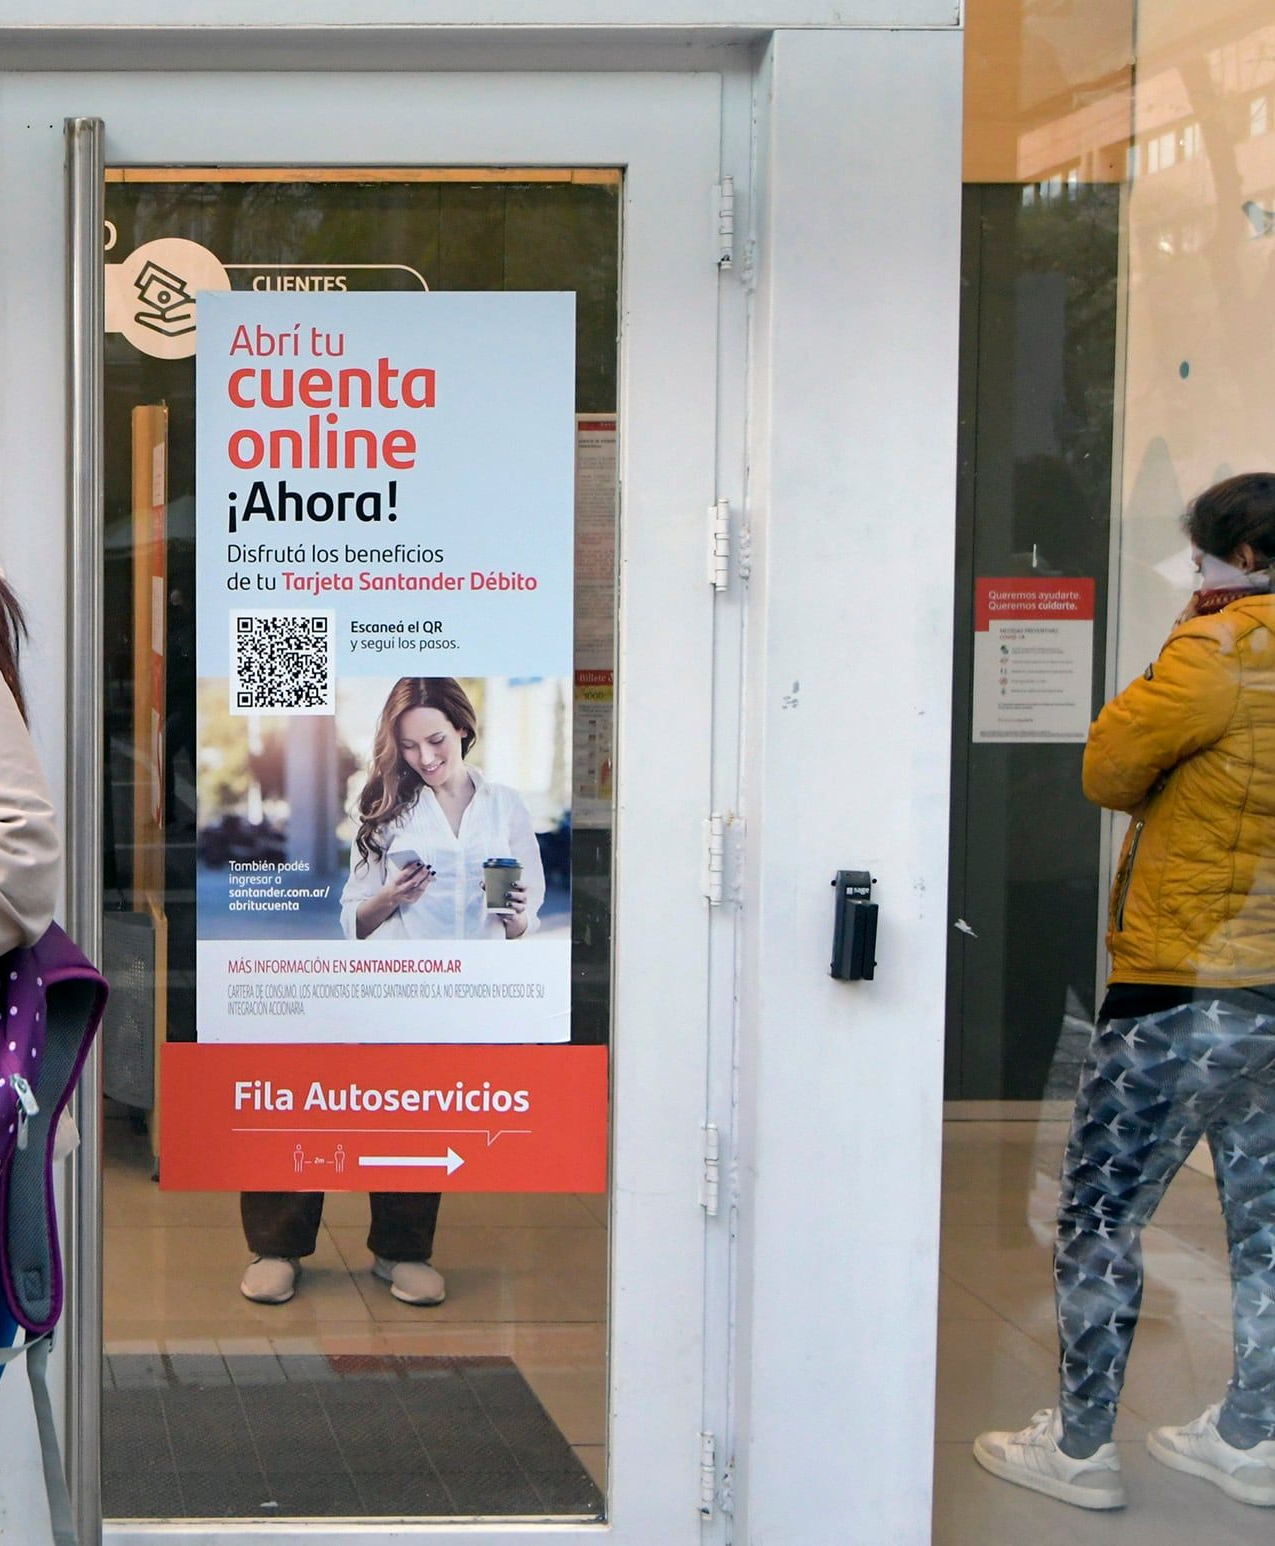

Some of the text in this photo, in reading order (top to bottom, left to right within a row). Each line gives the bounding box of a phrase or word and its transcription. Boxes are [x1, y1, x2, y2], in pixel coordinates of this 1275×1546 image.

[252, 275, 348, 292] CLIENTES
[229, 323, 345, 357] Abrí tu
[227, 357, 436, 409] cuenta
[227, 412, 417, 470] online
[228, 480, 398, 534] ¡Ahora!
[227, 544, 444, 563] Disfrutá los beneficios
[226, 571, 538, 596] de tu Tarjeta Santander Débito
[988, 590, 1036, 601] Queremos
[988, 600, 1036, 612] Queremos
[350, 620, 443, 635] Escaneá el QR
[350, 637, 460, 652] y seguí los pasos.
[229, 860, 310, 874] También podés
[229, 874, 282, 887] ingresar a
[229, 886, 330, 898] santander.com.ar/
[229, 900, 300, 911] abritucuenta
[227, 957, 462, 974] MÁS INFORMACIÓN EN SANTANDER.COM.AR
[227, 984, 255, 998] CARTERA
[256, 984, 264, 998] DE
[300, 984, 311, 998] LOS
[312, 984, 350, 998] ACCIONISTAS
[351, 984, 359, 998] DE
[360, 984, 382, 998] BANCO
[383, 984, 419, 998] SANTANDER
[444, 984, 454, 998] NO
[454, 984, 491, 998] RESPONDEN
[492, 984, 501, 998] EN
[501, 984, 525, 998] EXCESO
[526, 984, 535, 998] DE
[535, 984, 545, 998] SU
[227, 999, 268, 1015] INTEGRACIÓN
[234, 1079, 530, 1113] Fila Autoservicios
